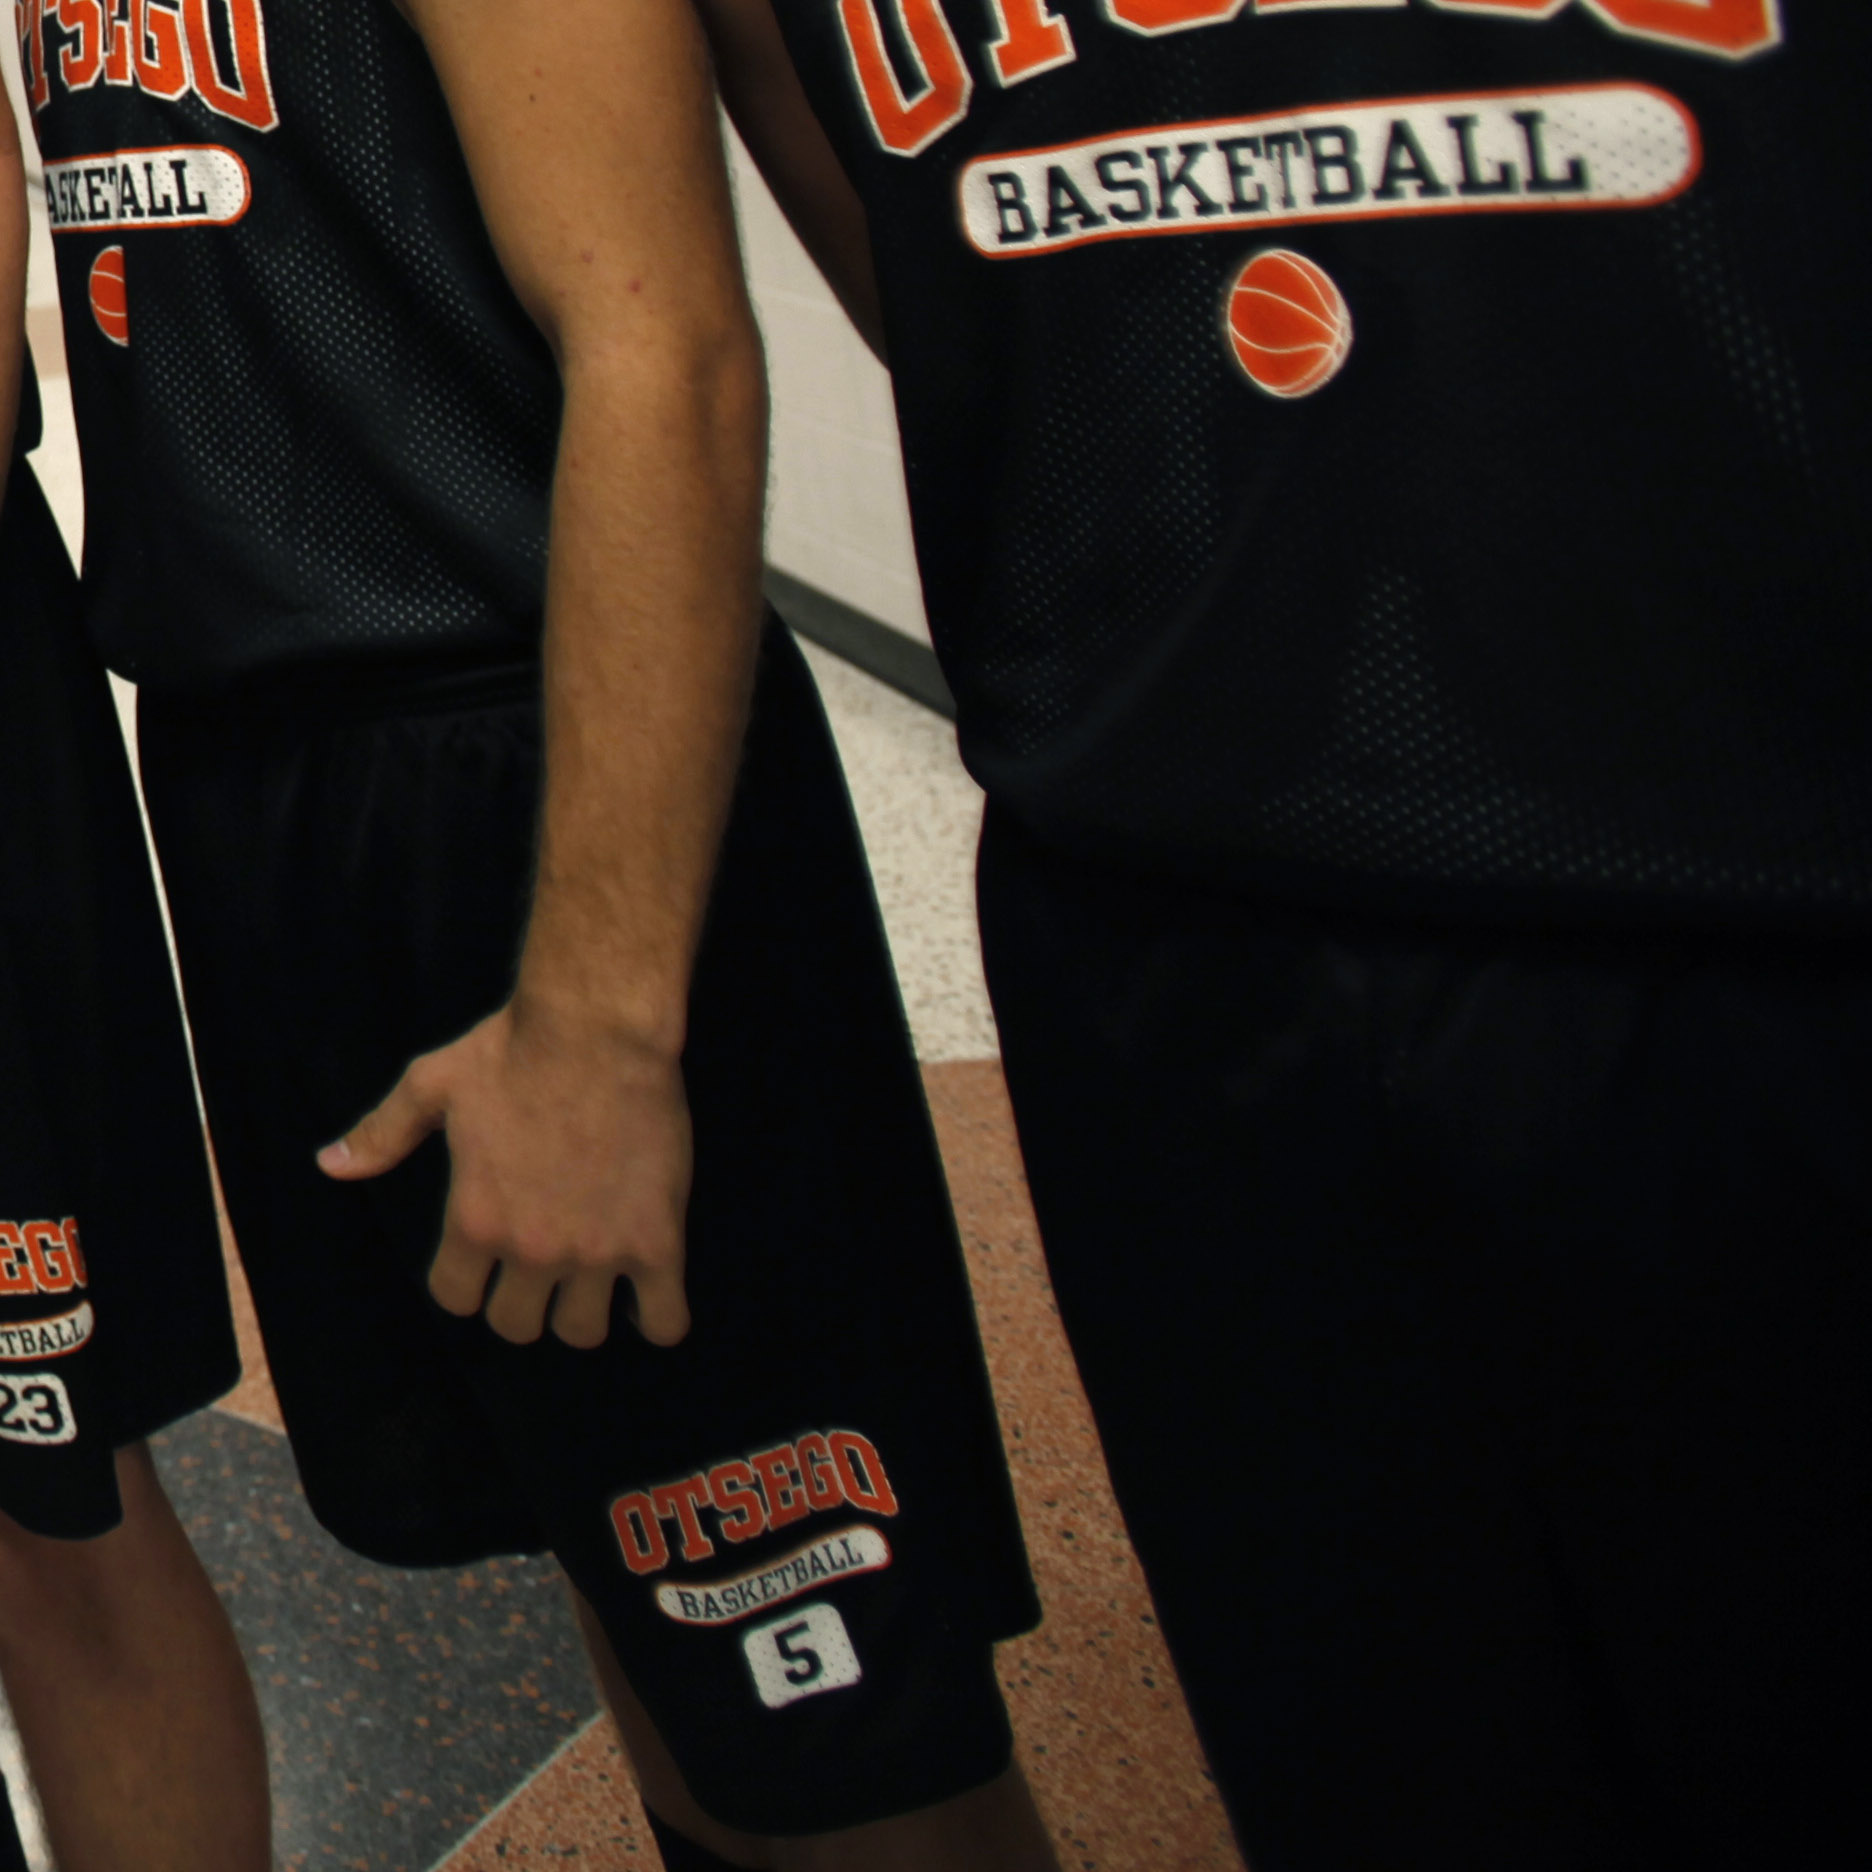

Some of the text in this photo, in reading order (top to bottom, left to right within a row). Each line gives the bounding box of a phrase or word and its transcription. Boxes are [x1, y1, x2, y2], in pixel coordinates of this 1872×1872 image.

[985, 109, 1592, 246] BASKETBALL
[609, 1429, 900, 1576] OTSEGO
[676, 1539, 866, 1619] BASKETBALL
[773, 1621, 825, 1686] 5
